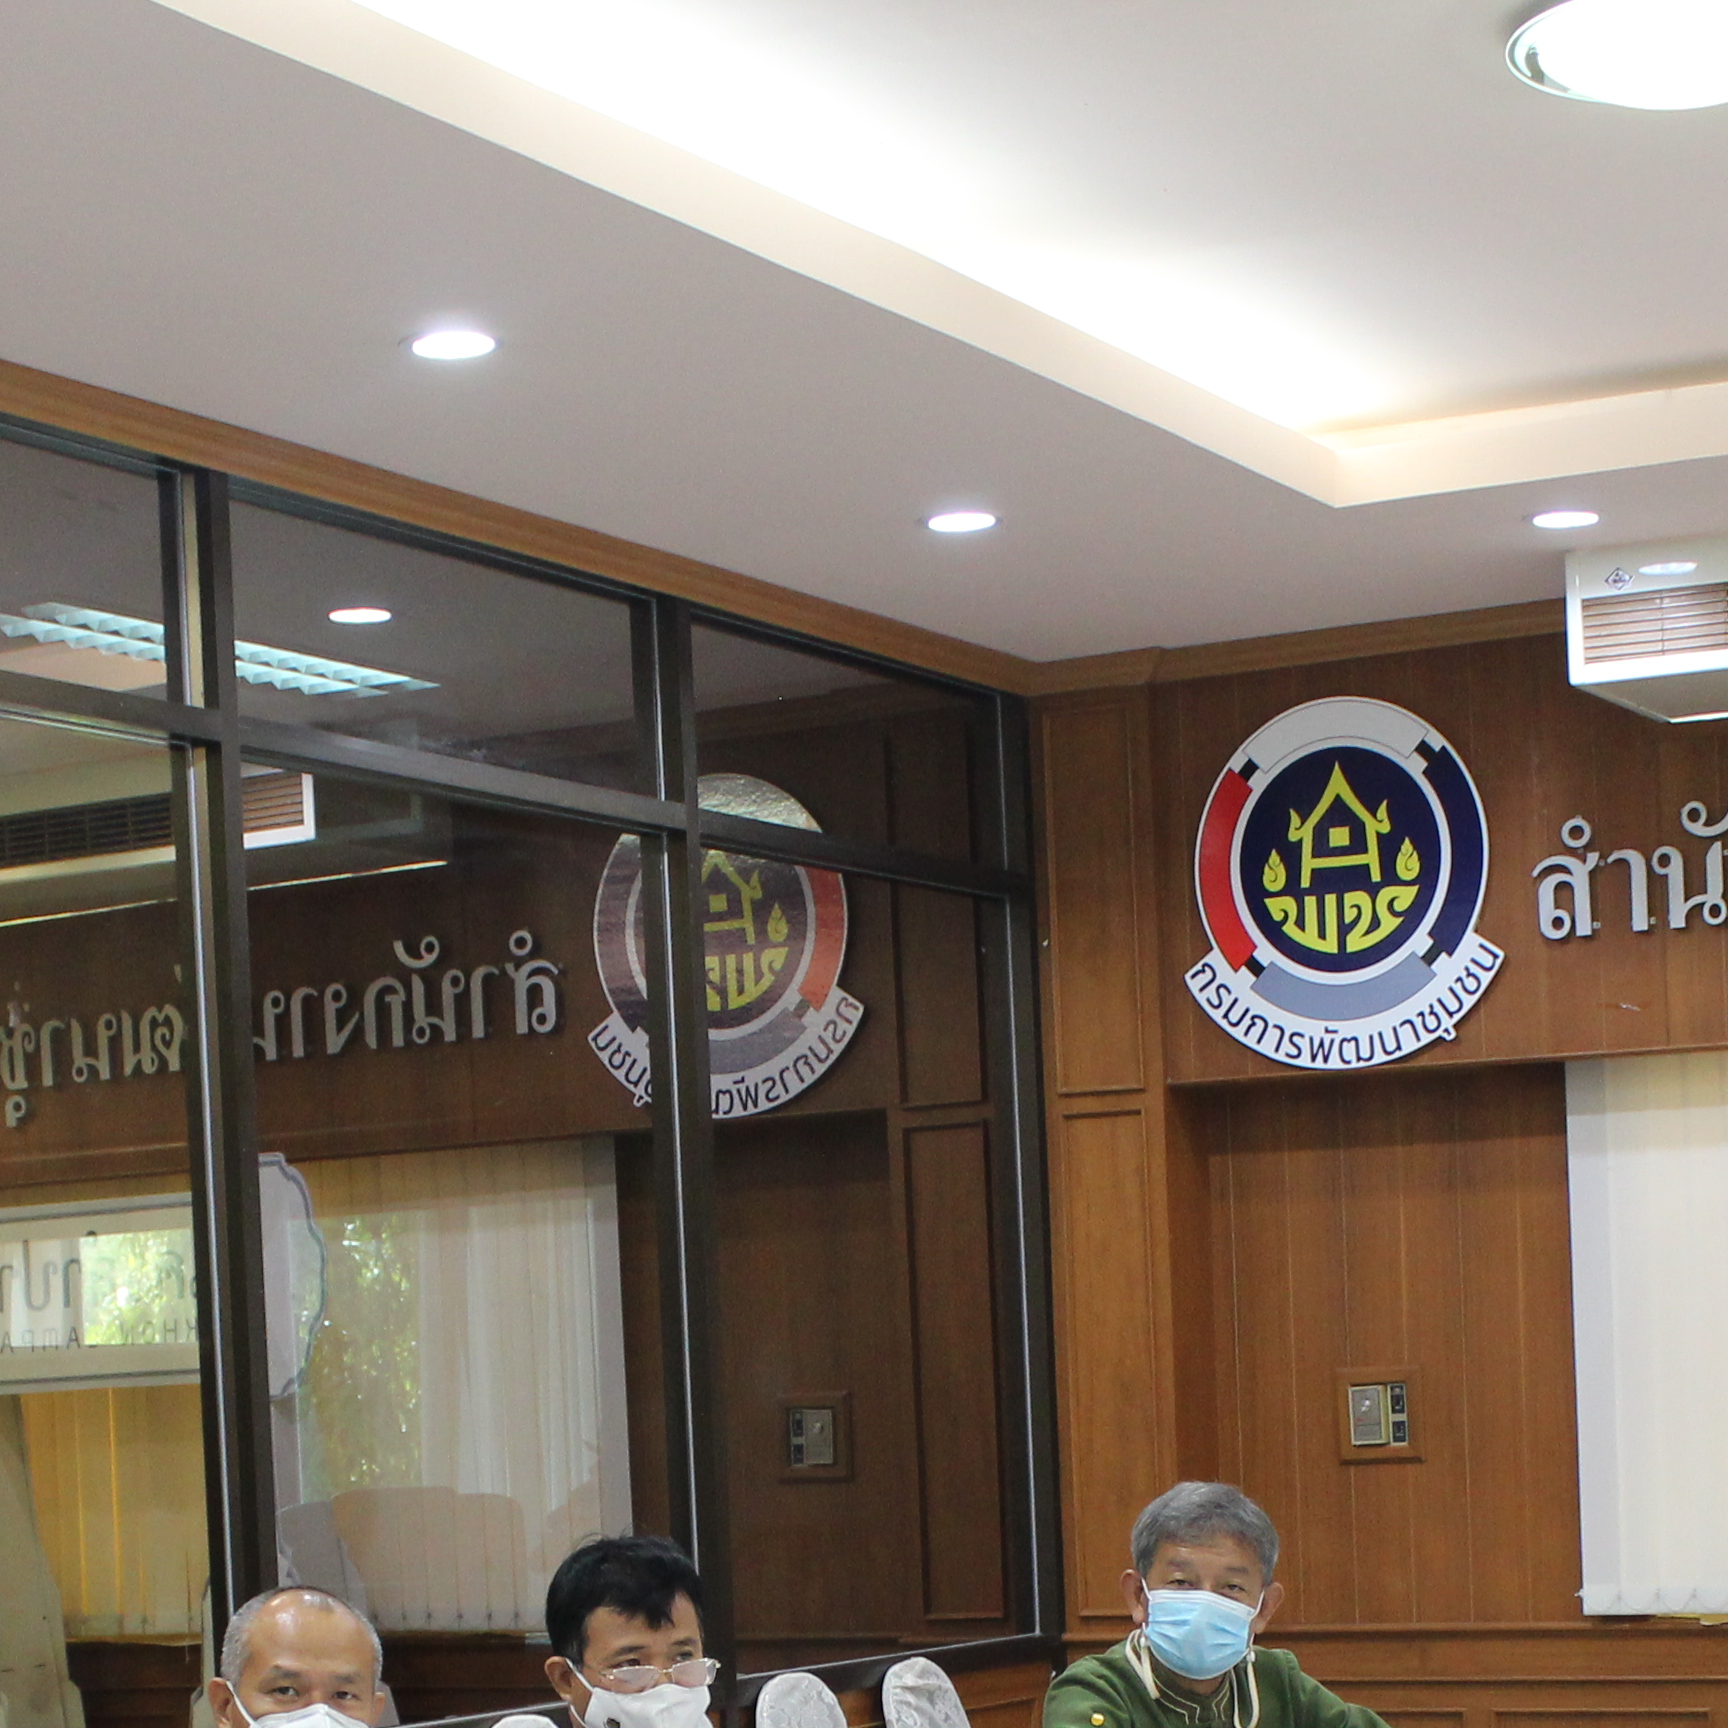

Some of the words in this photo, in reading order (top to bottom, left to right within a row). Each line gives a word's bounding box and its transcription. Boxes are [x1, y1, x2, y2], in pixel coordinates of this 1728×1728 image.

[1190, 943, 1500, 1065] กรมการพัฒนาชุมชน
